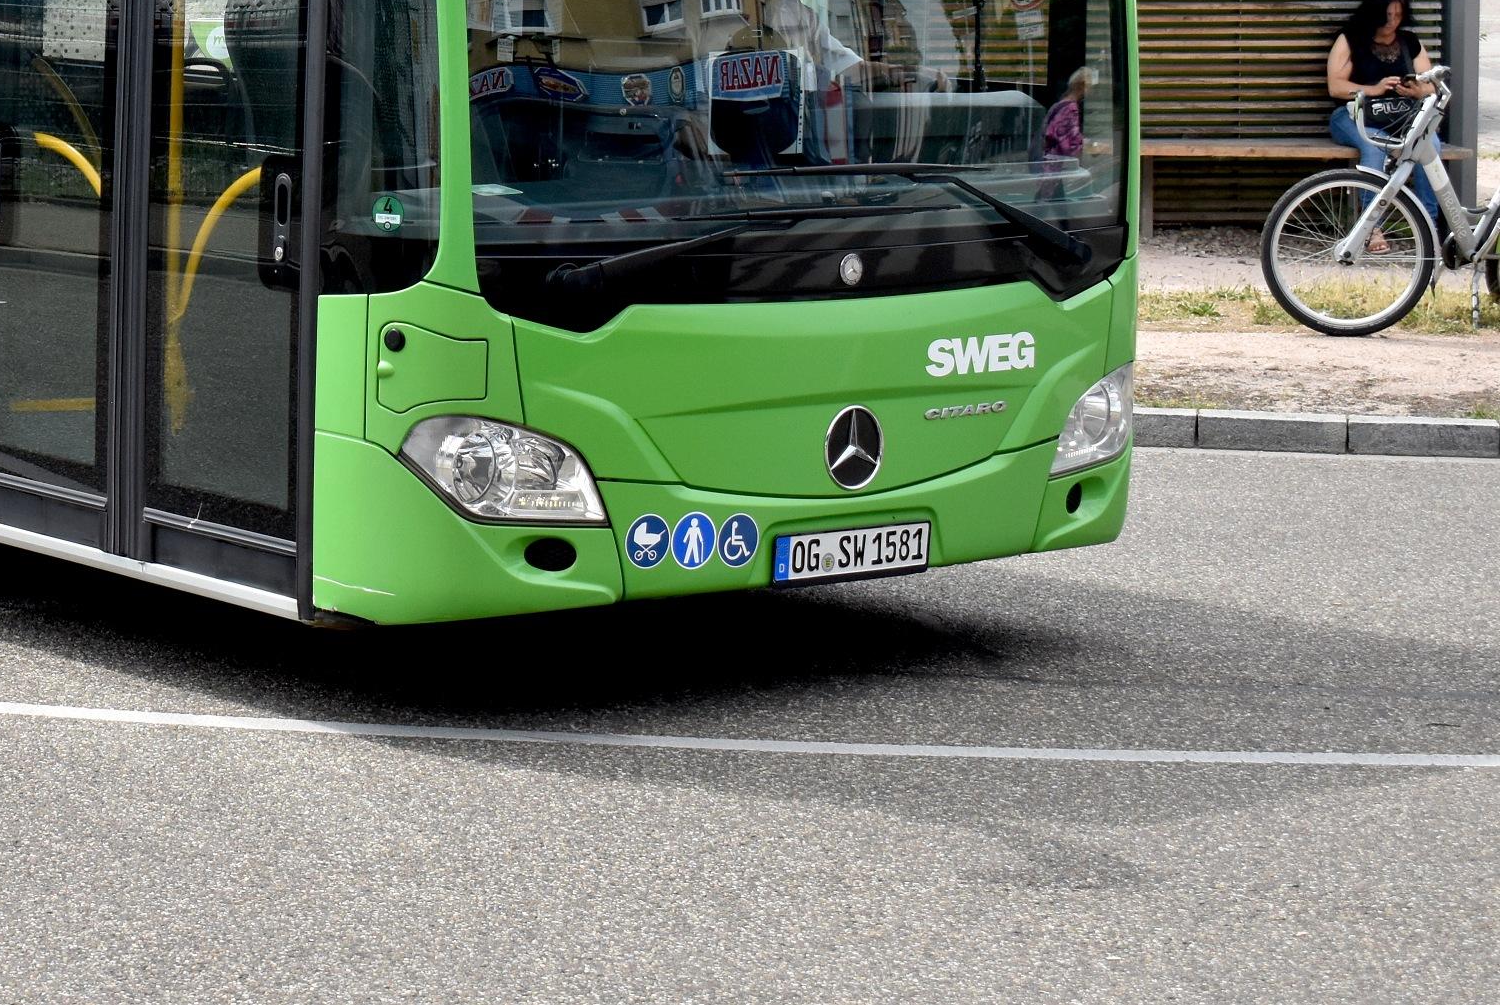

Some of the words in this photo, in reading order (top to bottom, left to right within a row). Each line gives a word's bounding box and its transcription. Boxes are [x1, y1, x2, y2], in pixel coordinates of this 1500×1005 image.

[1371, 101, 1411, 116] FILA
[925, 331, 1035, 377] SWEG
[924, 400, 1009, 421] CITARO
[792, 538, 821, 574] OG
[837, 533, 867, 568] SW
[871, 527, 924, 566] 1581
